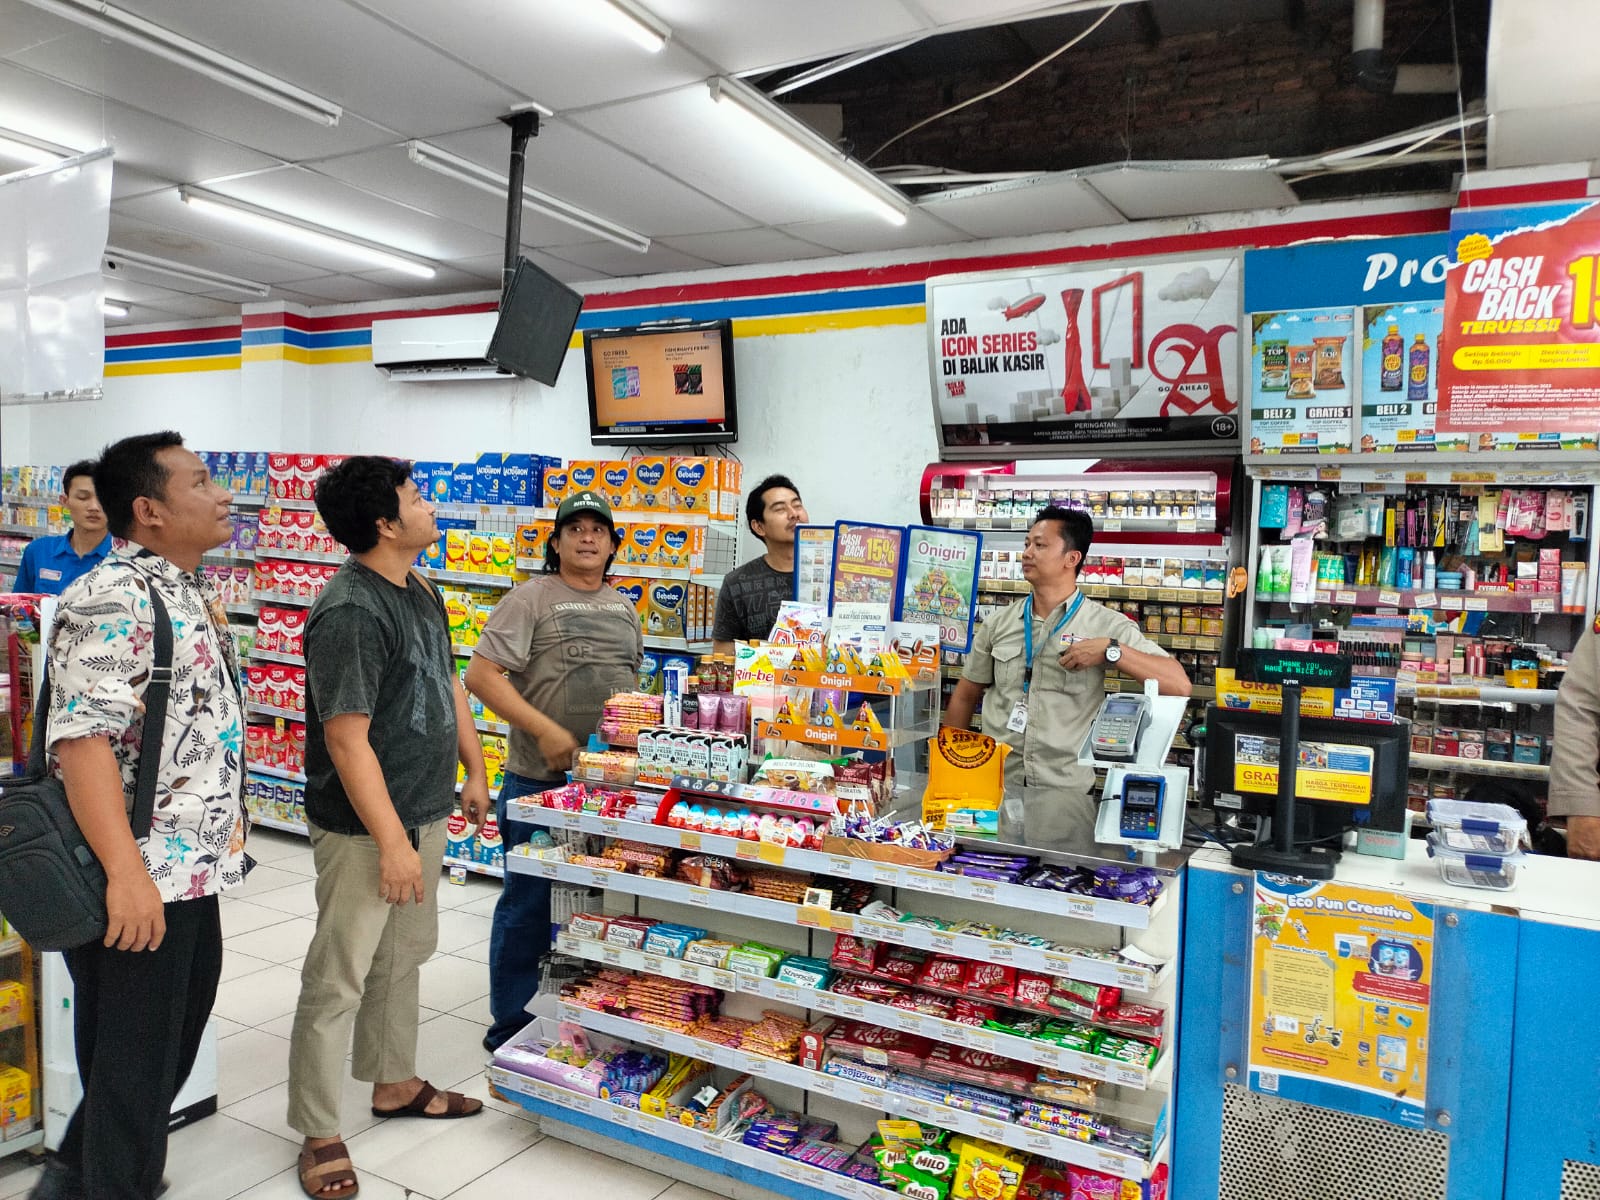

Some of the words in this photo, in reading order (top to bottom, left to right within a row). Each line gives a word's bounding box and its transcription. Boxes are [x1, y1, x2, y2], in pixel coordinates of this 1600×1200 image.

[1462, 256, 1544, 293] CASH
[1477, 285, 1562, 320] BACK
[941, 318, 967, 335] ADA
[942, 336, 978, 357] ICON
[983, 332, 1037, 354] SERIES
[1294, 356, 1310, 364] TOP
[1321, 351, 1338, 359] TOP
[943, 359, 956, 375] DI
[960, 356, 999, 375] BALIK
[1003, 353, 1045, 372] KASIR
[1263, 408, 1283, 419] BELI
[1285, 408, 1291, 418] 2
[1308, 407, 1345, 418] GRATIS
[1347, 407, 1352, 416] 1
[1377, 405, 1398, 416] BELI
[1400, 404, 1407, 415] 2
[1426, 405, 1437, 414] G
[1075, 421, 1117, 429] PERINGATAN
[1215, 422, 1233, 431] 18+
[274, 457, 288, 467] SGM
[300, 457, 314, 467] SGM
[574, 473, 593, 481] Bebelac
[607, 474, 625, 482] Bebelac
[638, 470, 661, 479] Bebelac
[677, 471, 701, 479] Bebelac
[493, 479, 499, 489] 3
[520, 480, 526, 490] 3
[662, 491, 669, 501] 3
[703, 493, 708, 503] 3
[841, 534, 861, 546] CASH
[844, 545, 866, 557] BACK
[867, 537, 895, 564] 15%
[918, 541, 967, 562] Onigiri
[656, 591, 680, 602] Bebelac
[567, 645, 590, 658] OF
[820, 675, 852, 688] Onigiri
[805, 728, 837, 741] Onigiri
[1287, 895, 1314, 909] Eco
[1316, 896, 1343, 911] Fun
[1346, 902, 1413, 921] Creative
[692, 944, 721, 958] Strepsils
[783, 967, 817, 984] Strepsils
[932, 964, 959, 979] KitKat
[976, 967, 1004, 983] KitKat
[1021, 984, 1050, 996] KitKat
[854, 1028, 900, 1043] KitKat
[1062, 1111, 1104, 1131] mentos
[915, 1155, 945, 1171] MILO
[906, 1186, 935, 1200] MILO
